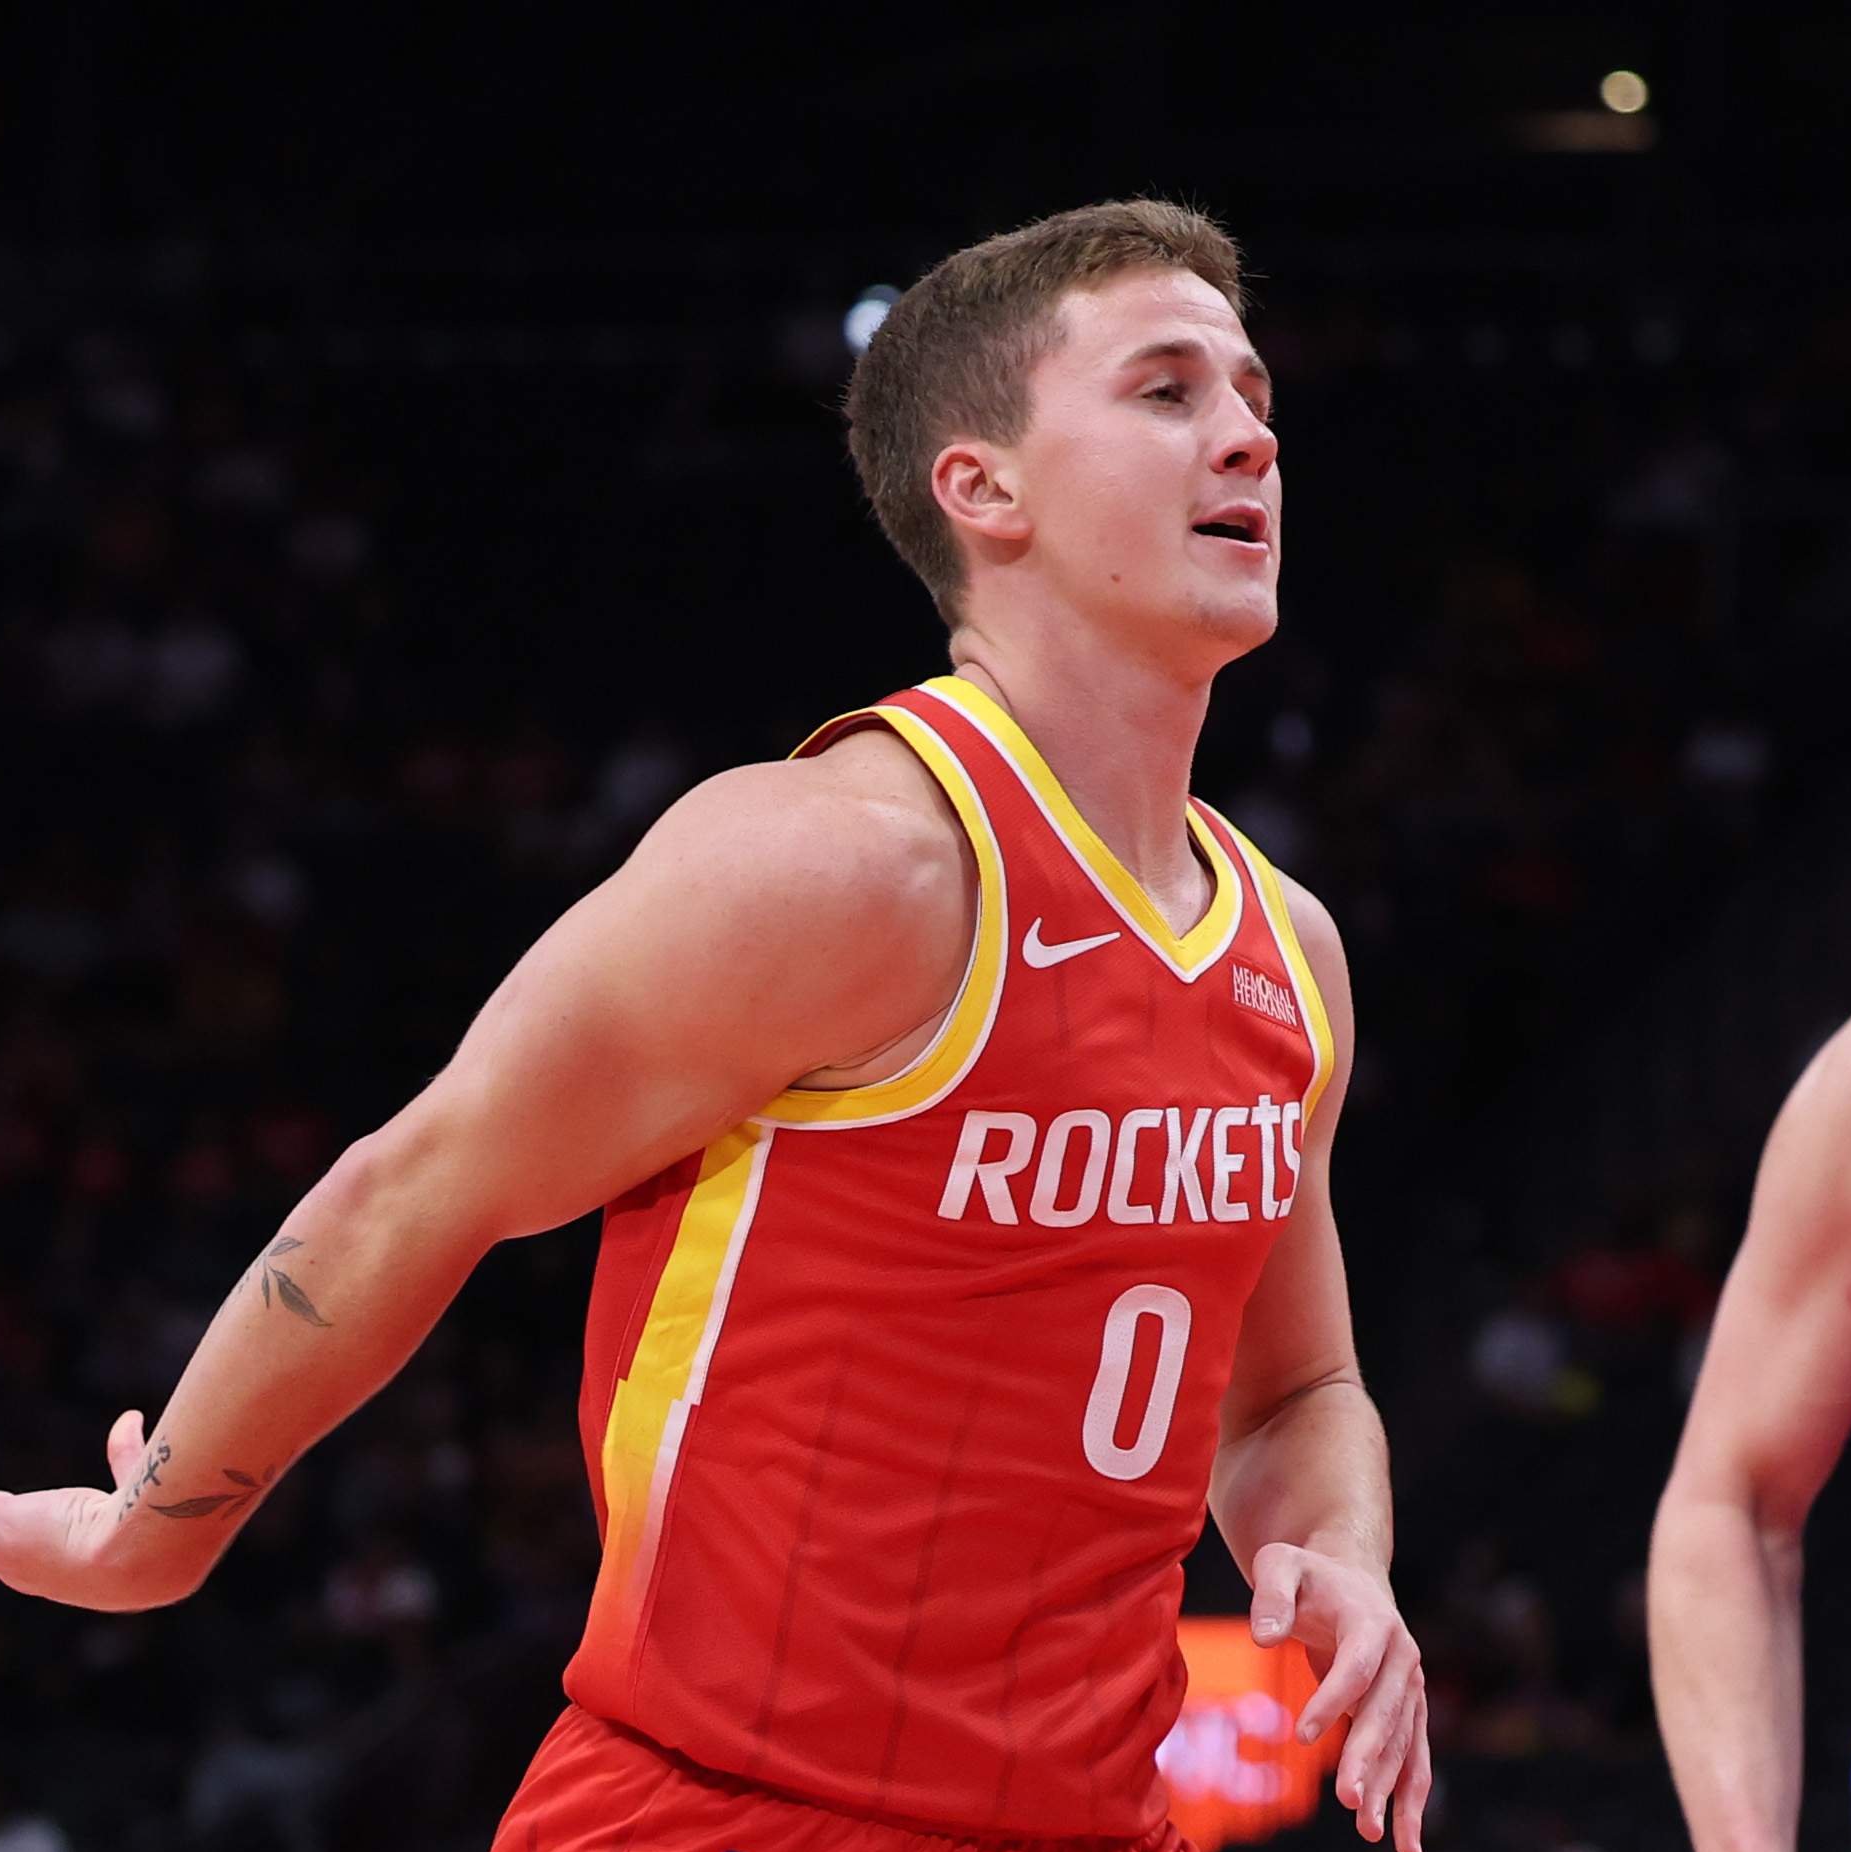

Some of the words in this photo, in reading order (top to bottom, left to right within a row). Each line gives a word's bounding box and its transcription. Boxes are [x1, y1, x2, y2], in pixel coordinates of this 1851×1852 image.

[1232, 963, 1293, 1007] MEMORIAL
[1233, 985, 1297, 1027] HERMANN
[937, 1094, 1302, 1228] ROCKETS
[1082, 1284, 1191, 1480] 0
